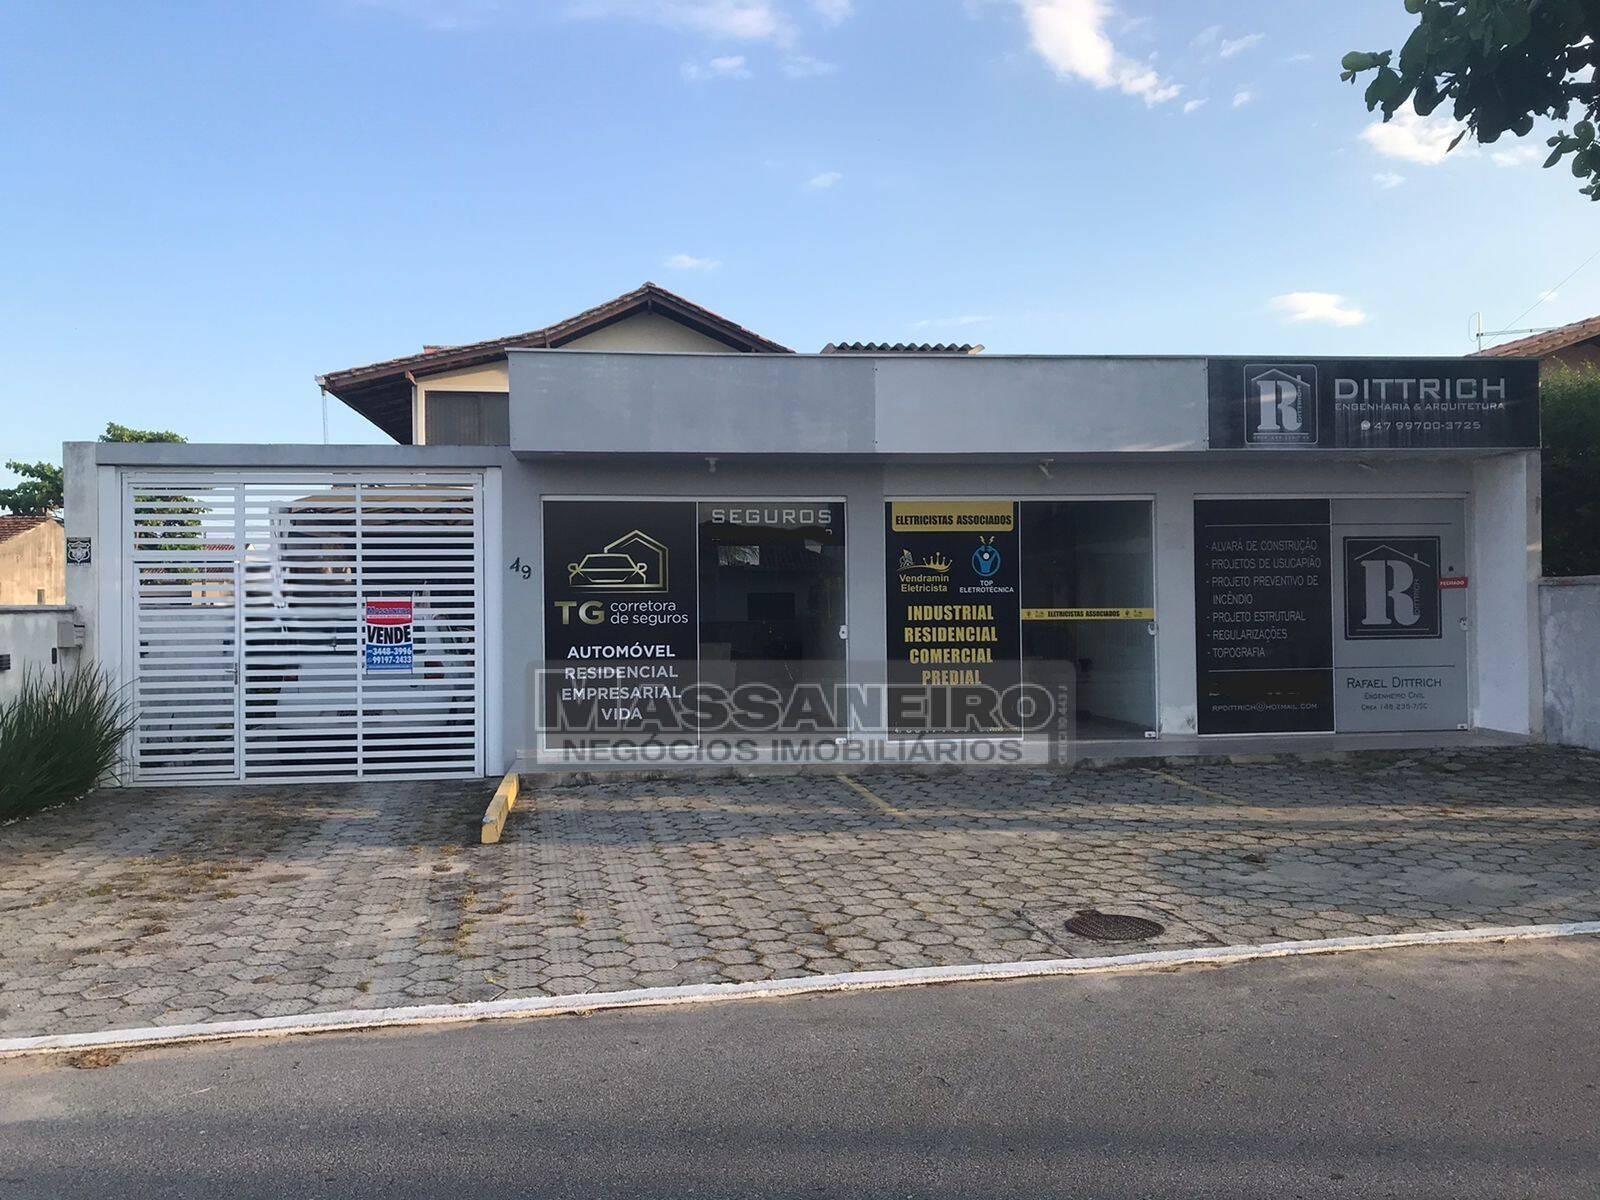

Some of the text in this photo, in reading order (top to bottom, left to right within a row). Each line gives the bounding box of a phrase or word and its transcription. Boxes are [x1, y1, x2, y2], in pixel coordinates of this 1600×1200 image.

[1334, 378, 1505, 399] DITTRICH
[1335, 403, 1410, 411] ENGENHARIA
[1425, 402, 1505, 411] ARQUITETURA
[1374, 421, 1481, 430] 47 99700-3725
[711, 509, 832, 524] SEGUROS
[896, 515, 1012, 525] ELETRICISTAS ASSOCIADOS
[1246, 541, 1258, 551] DE
[1260, 537, 1318, 554] CONSTRUÇÃO
[509, 557, 531, 580] 49
[1211, 559, 1256, 569] PROJETOS
[1259, 558, 1271, 569] DE
[899, 574, 949, 582] Vendramin
[1212, 575, 1319, 587] PROJETO PREVENTIVO DE
[901, 583, 948, 593] Eletricista
[554, 600, 676, 625] TG corretora
[610, 612, 689, 627] de seguros
[907, 605, 994, 621] INDUSTRIAL
[1047, 610, 1084, 618] ELETRICISTAS
[1085, 610, 1120, 618] ASSOCIADOS
[1212, 611, 1306, 622] PROJETO ESTRUTURAL
[366, 624, 412, 645] VENDE
[904, 626, 998, 643] RESIDENCIAL
[567, 642, 675, 659] AUTOMÓVEL
[909, 648, 993, 664] COMERCIAL
[1212, 647, 1266, 658] TOPOGRAFIA
[564, 665, 679, 680] RESIDENCIAL
[922, 669, 982, 685] PREDIAL
[1347, 677, 1442, 688] RAFAEL DITTRICH
[561, 686, 682, 701] EMPRESARIAL
[601, 708, 643, 721] VIDA
